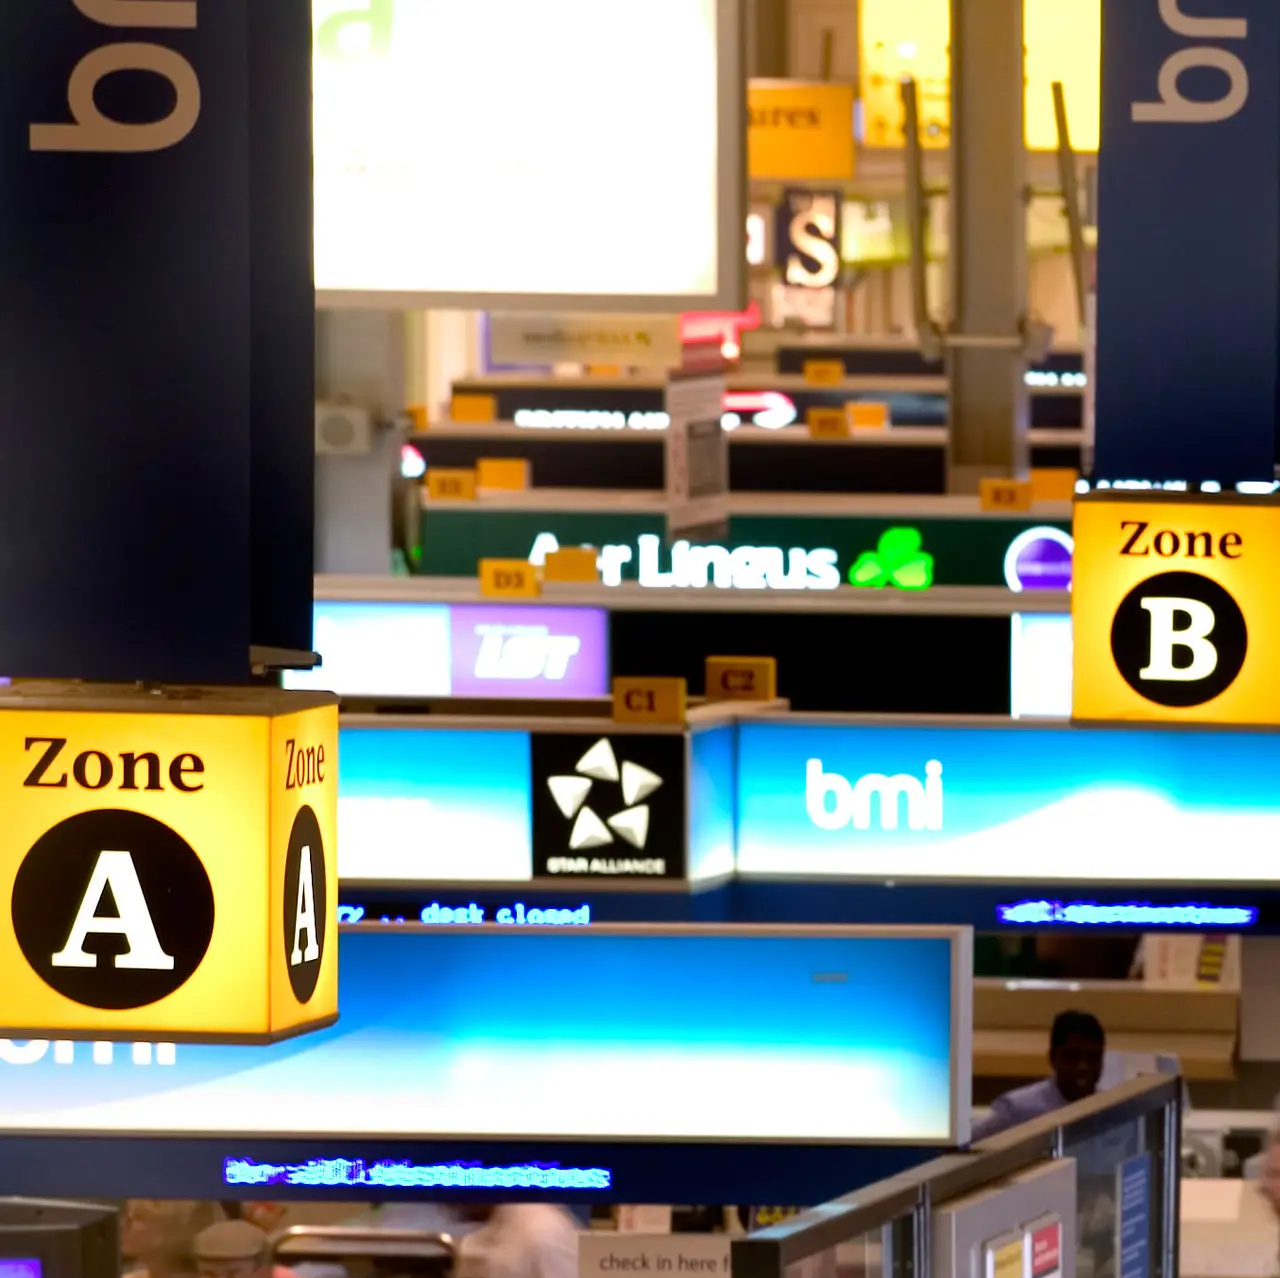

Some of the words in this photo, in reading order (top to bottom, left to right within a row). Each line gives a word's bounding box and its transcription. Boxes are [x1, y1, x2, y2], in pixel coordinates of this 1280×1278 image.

[1119, 520, 1244, 560] Zone
[1139, 597, 1219, 682] B
[623, 688, 657, 713] C1
[720, 668, 756, 692] C2
[23, 737, 205, 792] Zone
[285, 737, 326, 790] Zone
[805, 758, 944, 831] bmi
[546, 856, 589, 874] STAR
[589, 857, 666, 876] ALLIANCE
[51, 849, 175, 970] A
[290, 845, 320, 967] A
[600, 1253, 651, 1271] check
[656, 1254, 673, 1271] in
[678, 1254, 718, 1273] here
